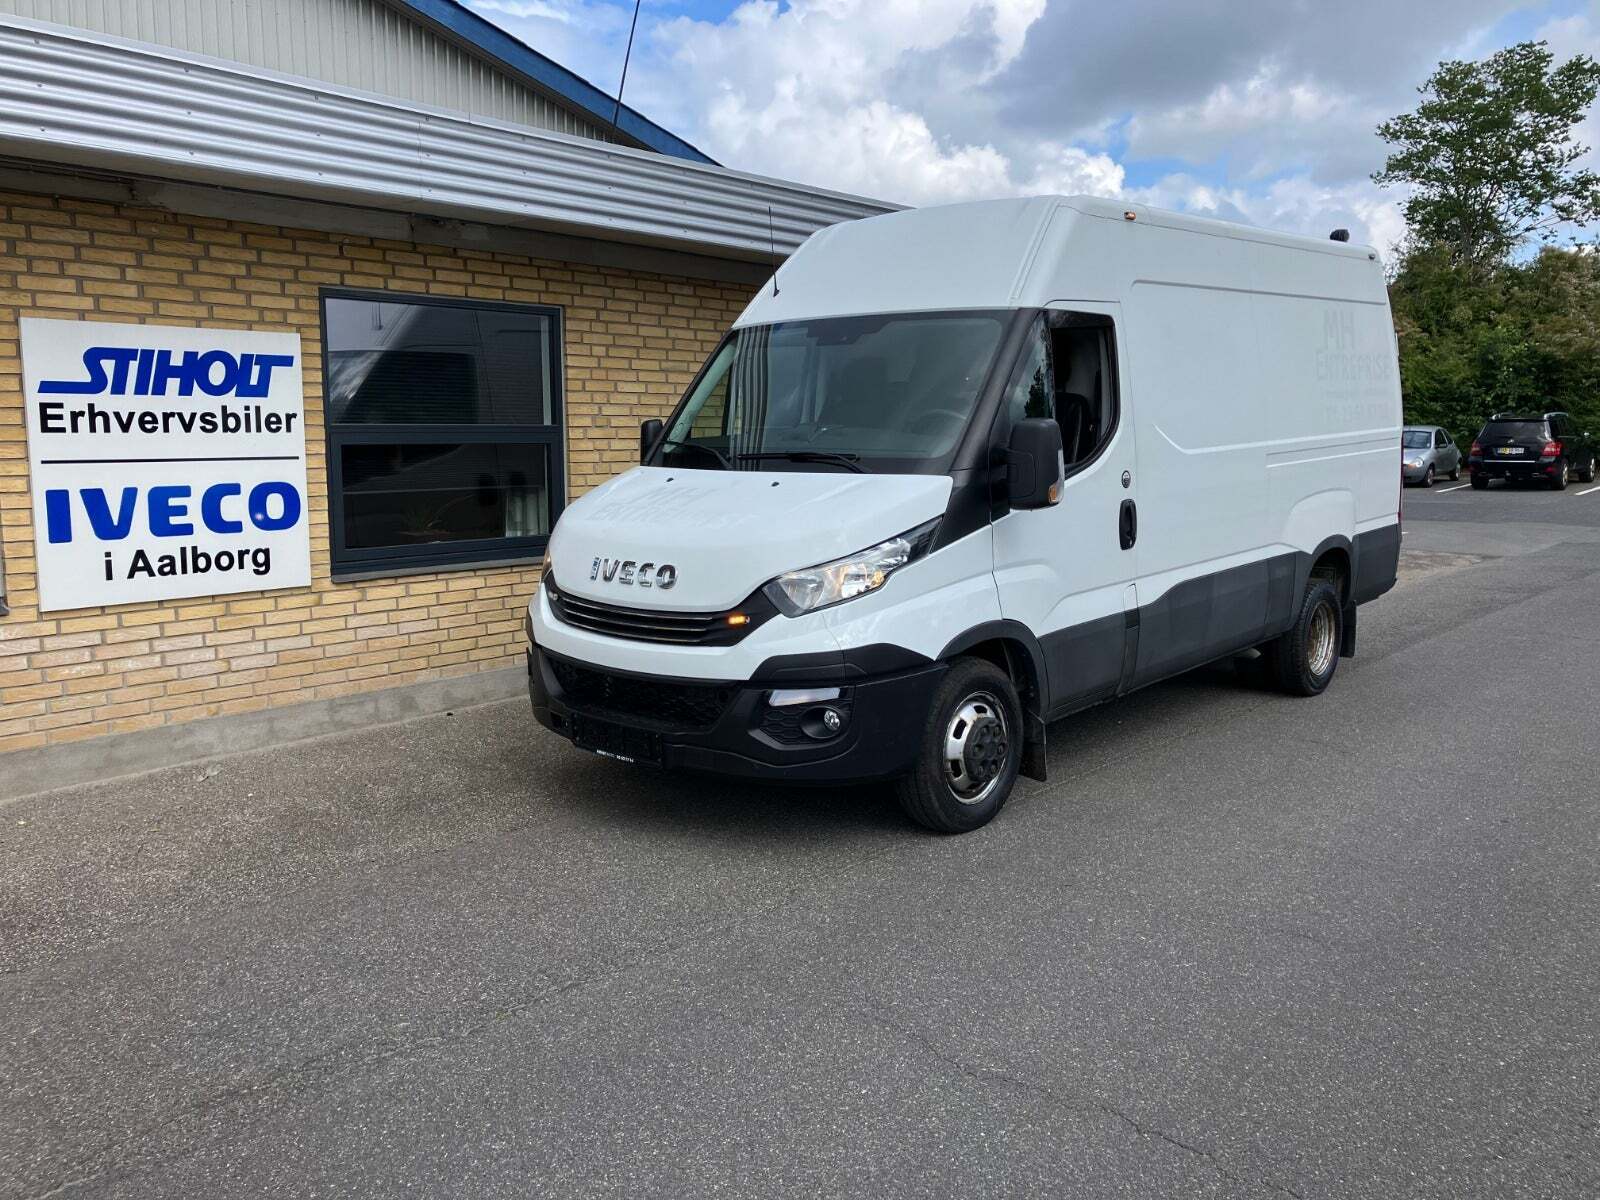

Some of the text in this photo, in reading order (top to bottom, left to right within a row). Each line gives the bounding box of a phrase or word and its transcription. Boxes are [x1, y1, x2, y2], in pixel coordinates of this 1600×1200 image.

[37, 346, 295, 398] STIHOLT
[38, 402, 298, 434] Erhvervsbiler
[45, 481, 302, 544] IVECO
[104, 546, 271, 581] i Aalborg
[590, 557, 678, 590] IVECO
